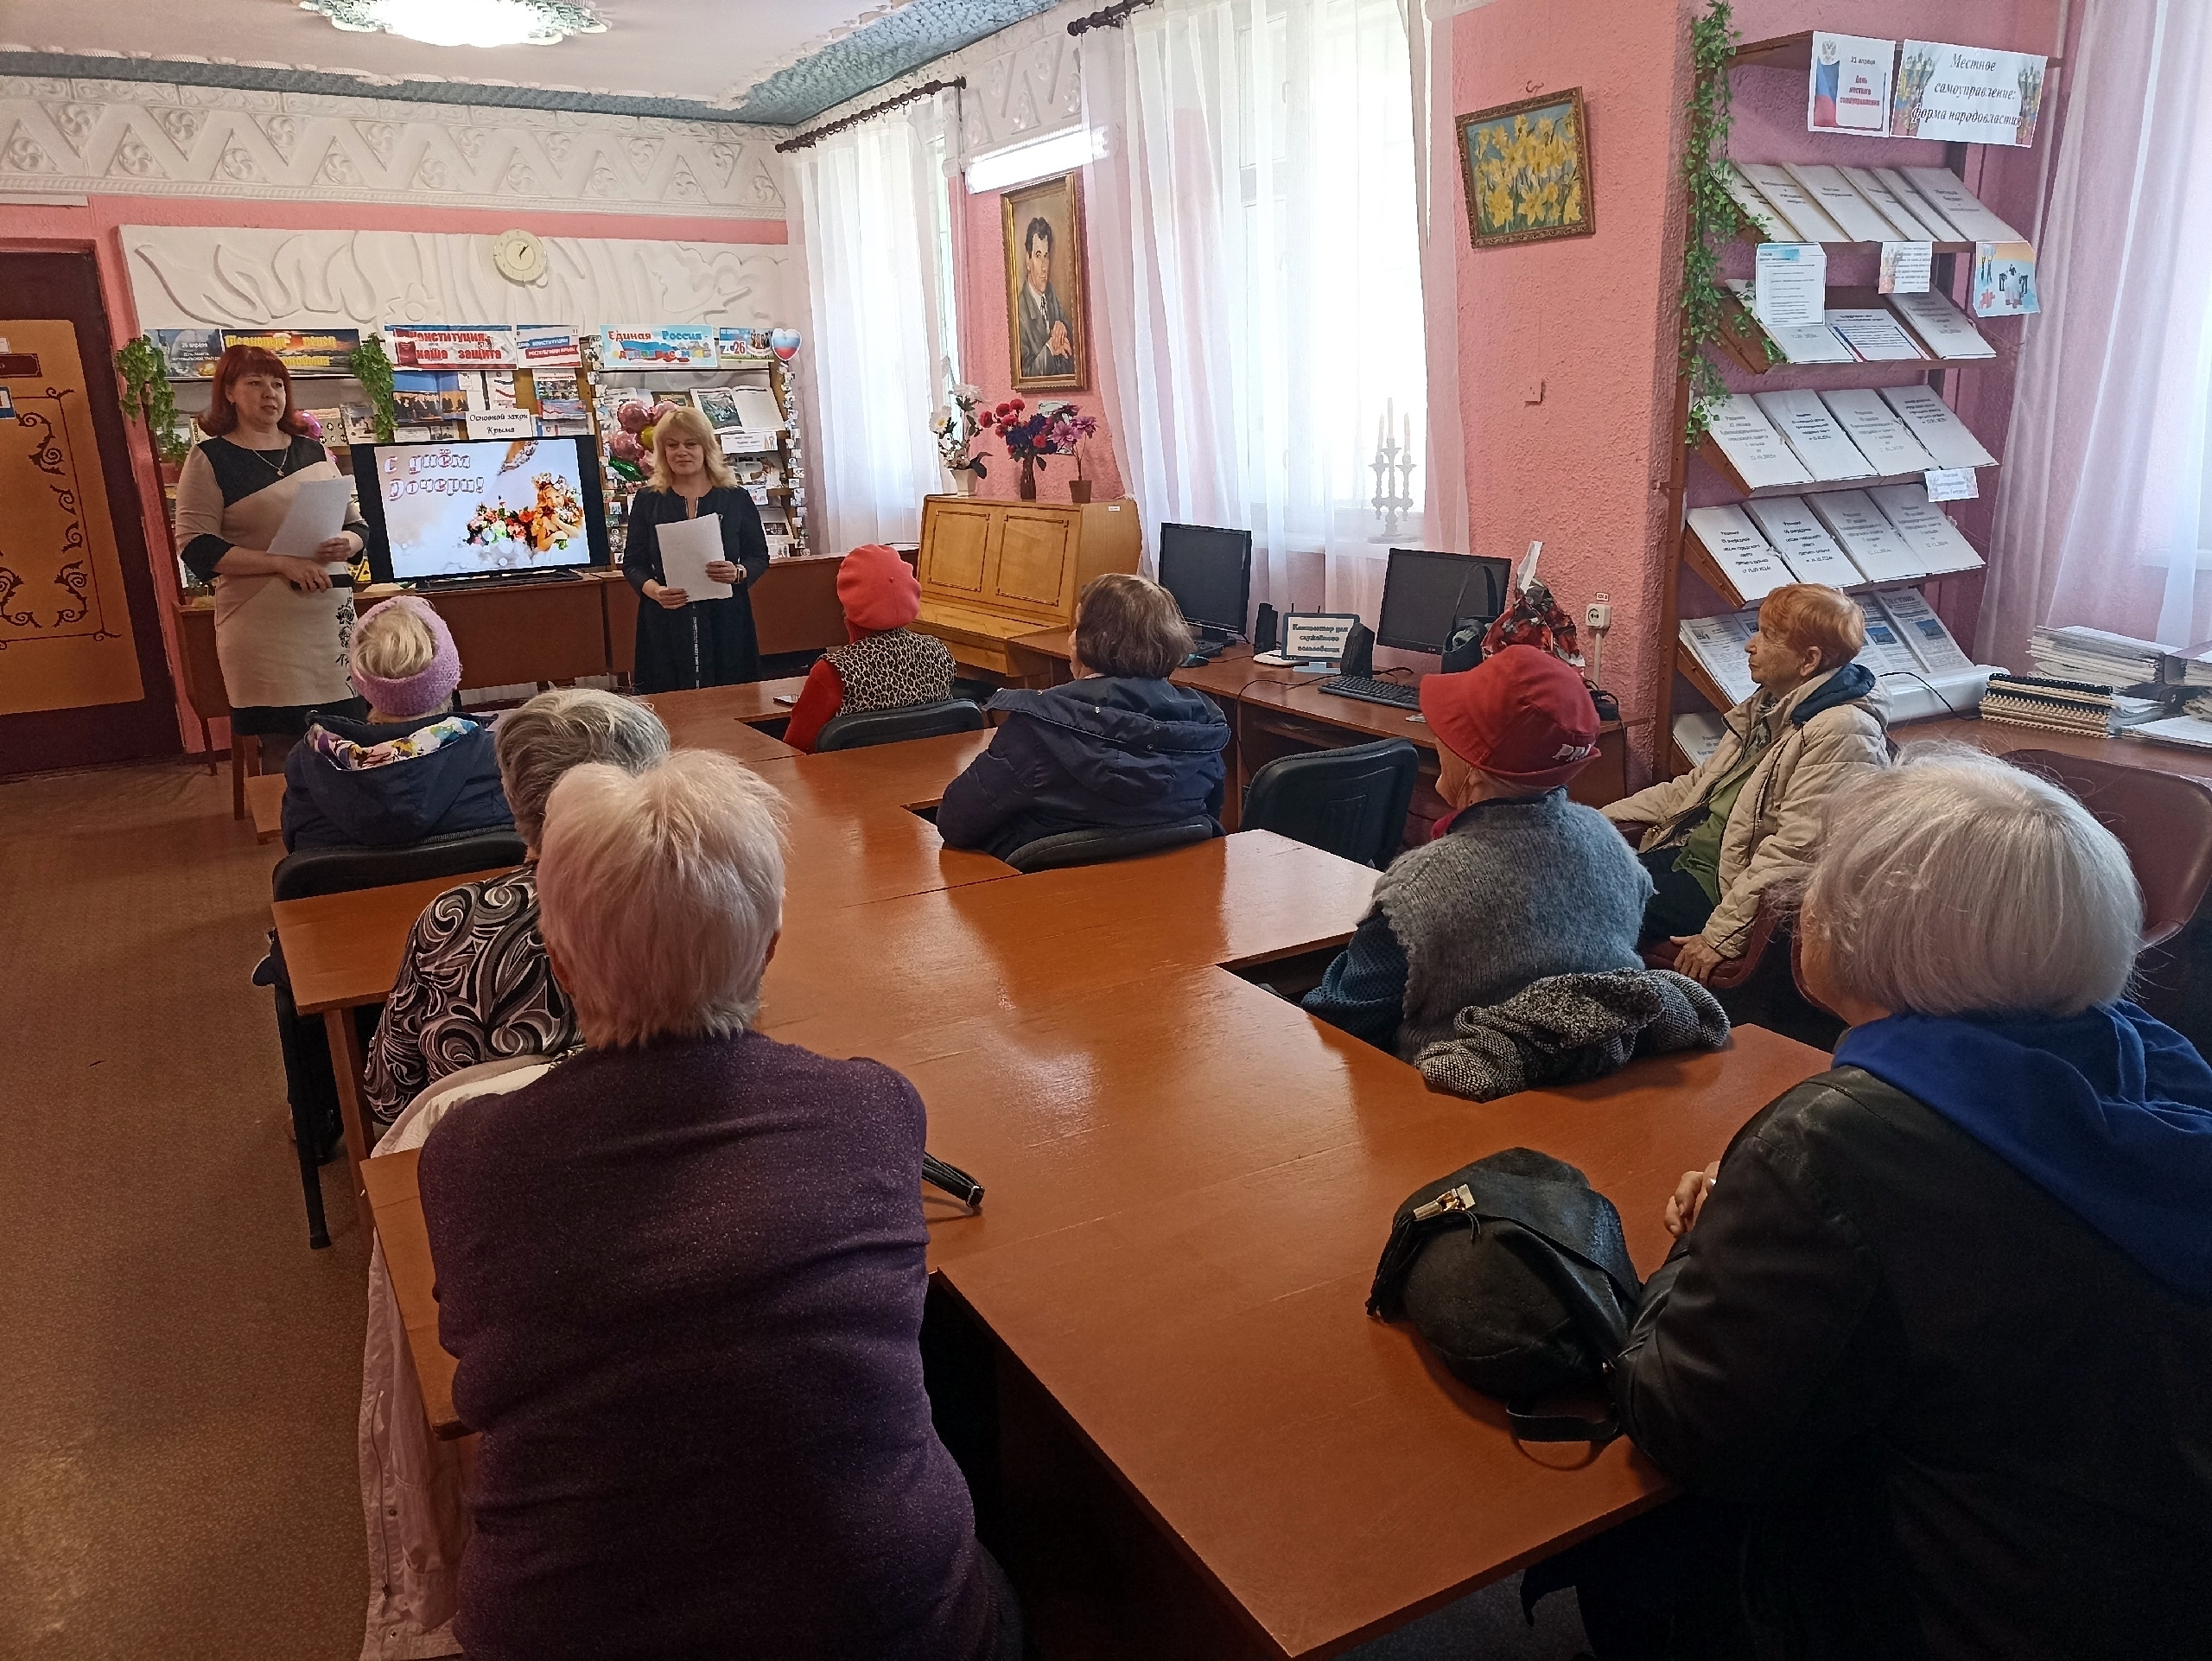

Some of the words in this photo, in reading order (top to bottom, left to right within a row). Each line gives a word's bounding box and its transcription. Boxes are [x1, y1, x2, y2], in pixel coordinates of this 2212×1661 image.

[1950, 53, 1996, 72] Местное
[1934, 81, 2016, 100] самоуправление:
[1911, 104, 1947, 124] форма
[1948, 110, 2022, 127] народовластия
[608, 330, 652, 341] Единая
[662, 330, 702, 340] Россия
[416, 349, 448, 359] наша
[458, 349, 501, 360] защита
[486, 426, 515, 436] Крыма
[409, 449, 470, 474] днём
